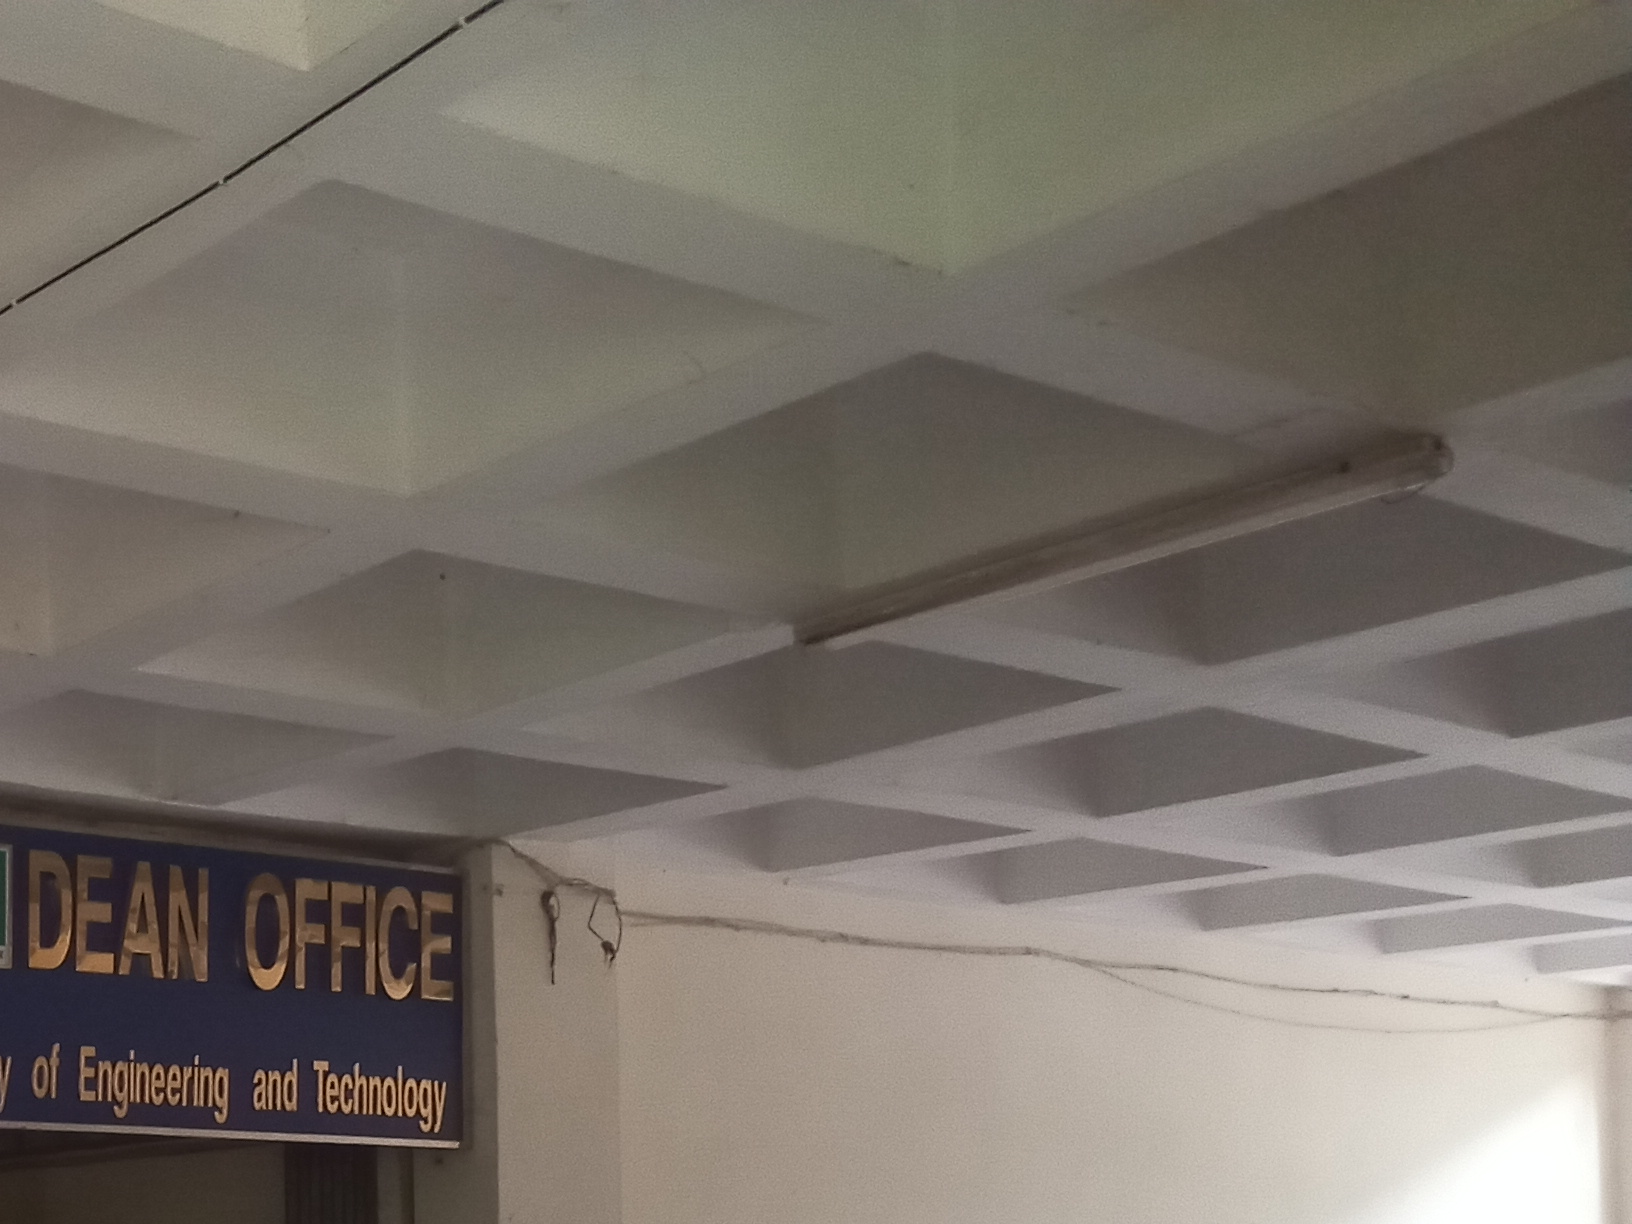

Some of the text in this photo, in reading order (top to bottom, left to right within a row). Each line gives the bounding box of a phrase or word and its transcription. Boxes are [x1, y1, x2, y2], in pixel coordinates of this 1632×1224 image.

[28, 849, 454, 1002] DEAN OFFICE
[31, 1042, 60, 1099] of
[78, 1045, 230, 1124] Engineering
[252, 1058, 299, 1112] and
[313, 1060, 447, 1134] Technology
